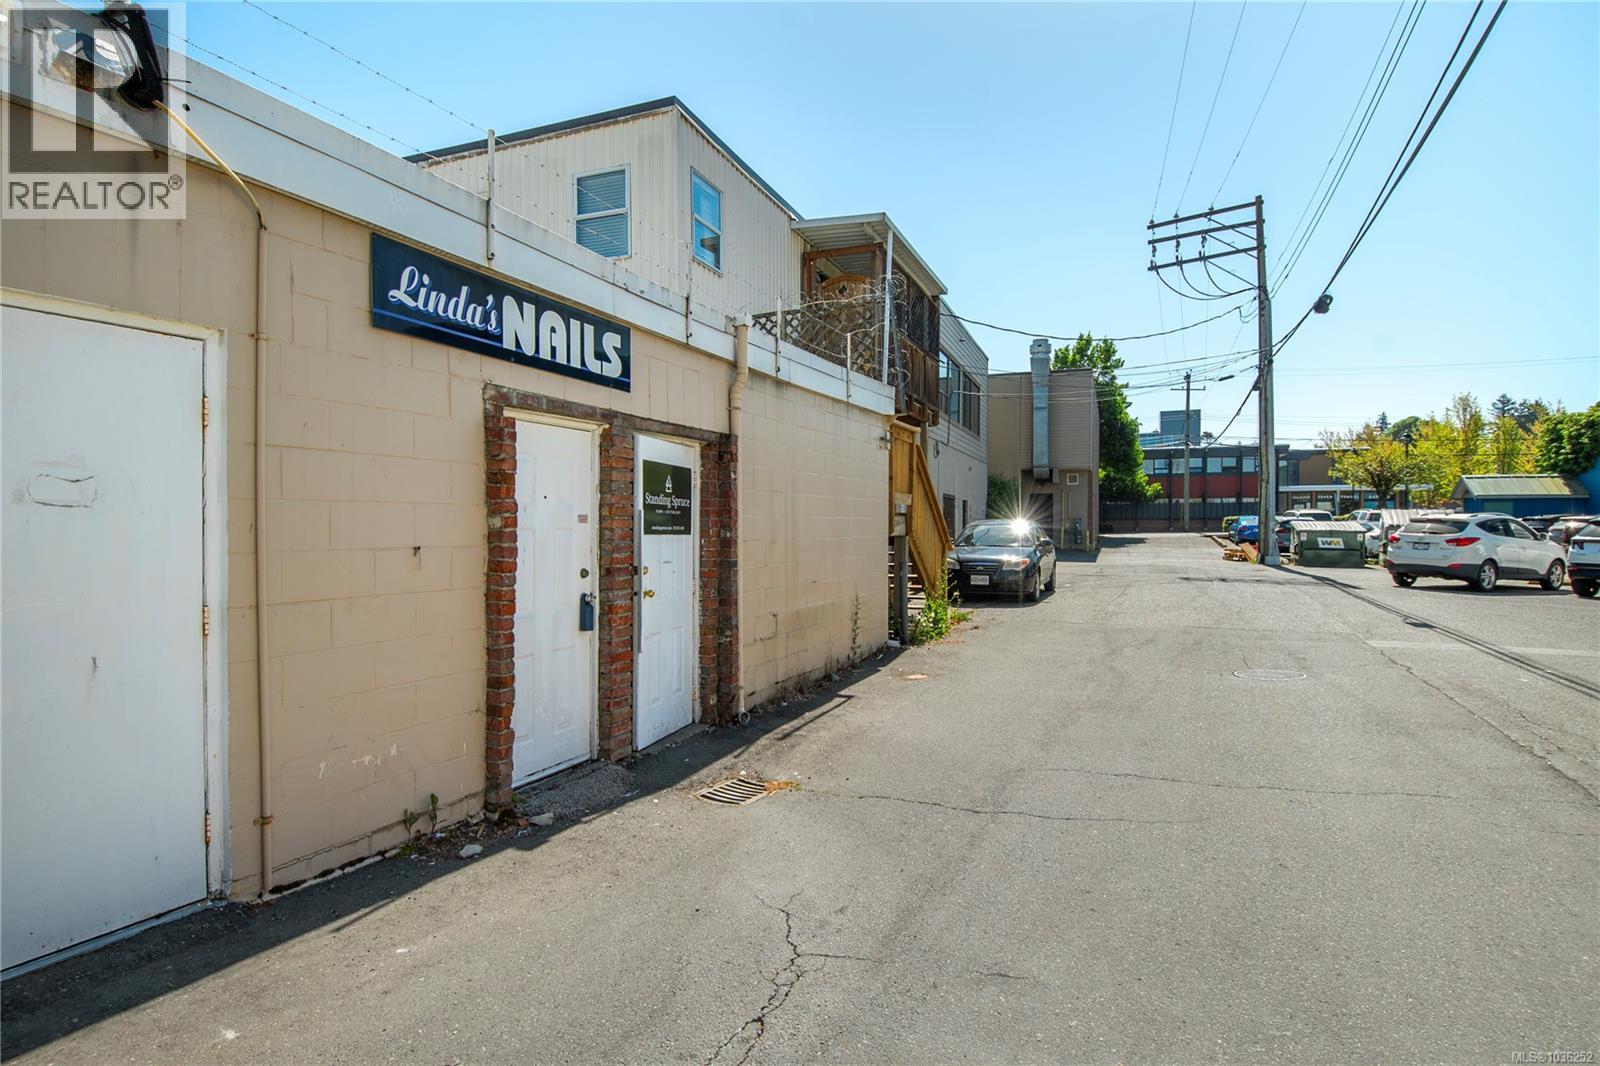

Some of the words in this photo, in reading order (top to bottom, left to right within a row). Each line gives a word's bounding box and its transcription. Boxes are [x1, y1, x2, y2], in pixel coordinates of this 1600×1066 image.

[388, 265, 501, 336] Linda's
[502, 295, 622, 378] NAILS
[645, 492, 672, 509] Standing
[672, 495, 690, 509] Spruce
